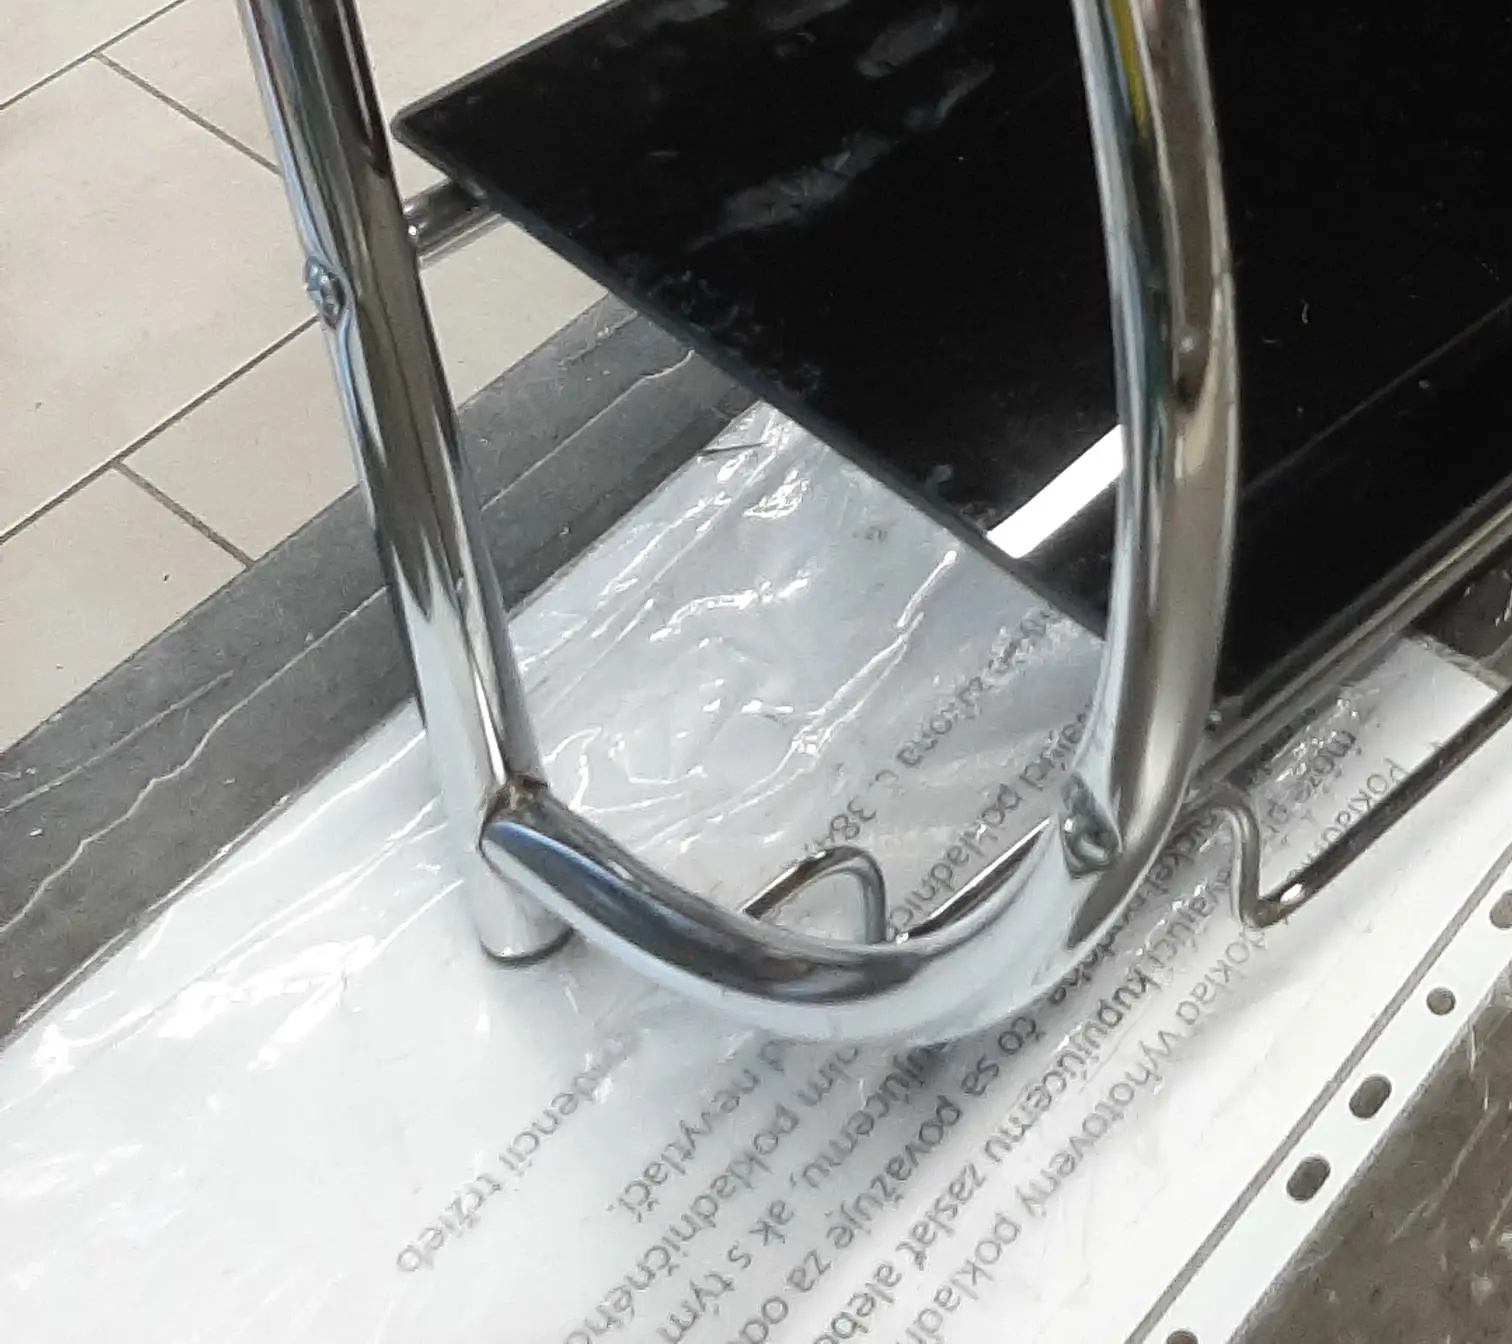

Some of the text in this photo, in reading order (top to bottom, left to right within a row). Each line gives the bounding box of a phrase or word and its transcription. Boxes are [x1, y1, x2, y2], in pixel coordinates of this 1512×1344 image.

[960, 1054, 1001, 1098] sa
[982, 966, 1163, 1165] kupujúcemu
[1014, 1029, 1183, 1218] vyhotovený
[825, 1094, 964, 1250] považuje
[747, 1199, 795, 1247] ak
[894, 1162, 988, 1272] zaslať
[726, 1244, 753, 1270] s
[786, 1248, 832, 1294] za
